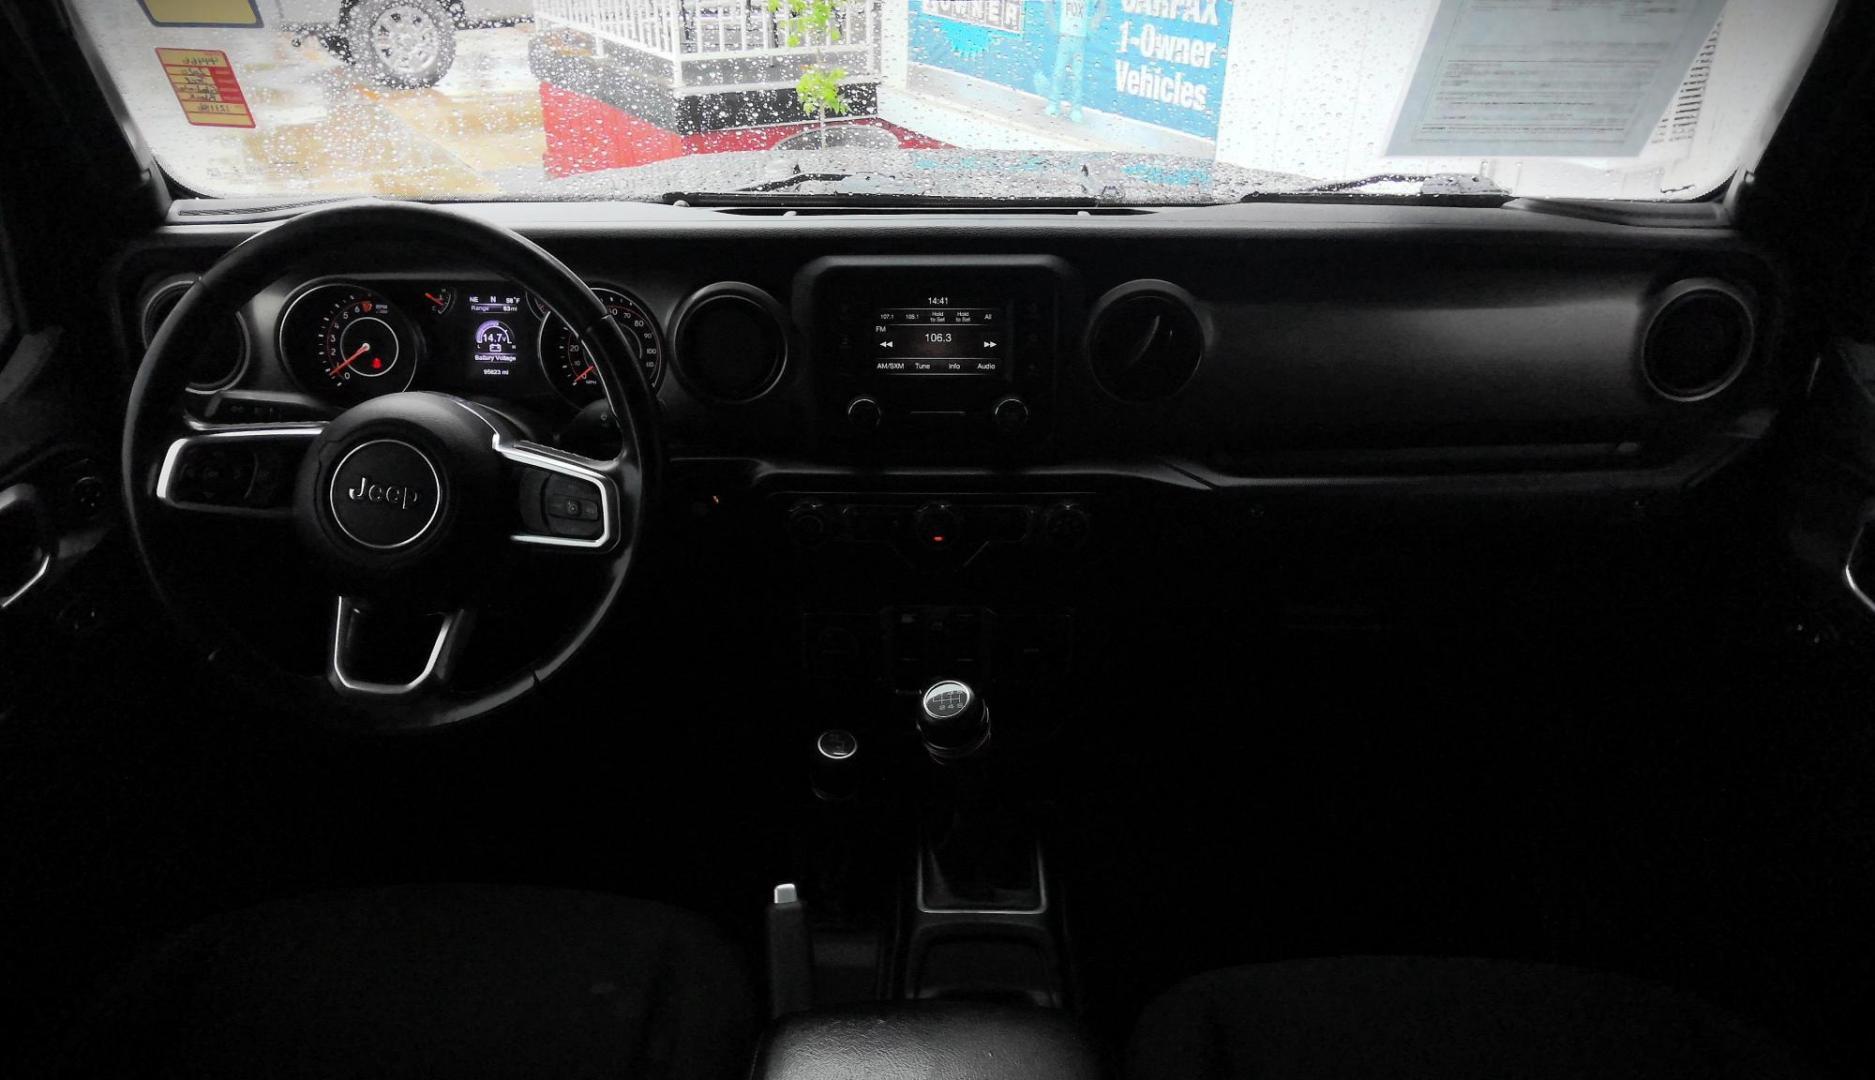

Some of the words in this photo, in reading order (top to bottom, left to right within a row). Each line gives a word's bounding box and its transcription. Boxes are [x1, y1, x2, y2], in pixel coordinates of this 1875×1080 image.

[1065, 3, 1085, 18] FOX
[1118, 22, 1217, 69] 1-Owner
[1116, 59, 1208, 111] Vehicles
[928, 297, 949, 305] 14:41
[925, 333, 952, 342] 106.3
[349, 477, 419, 509] Jeep
